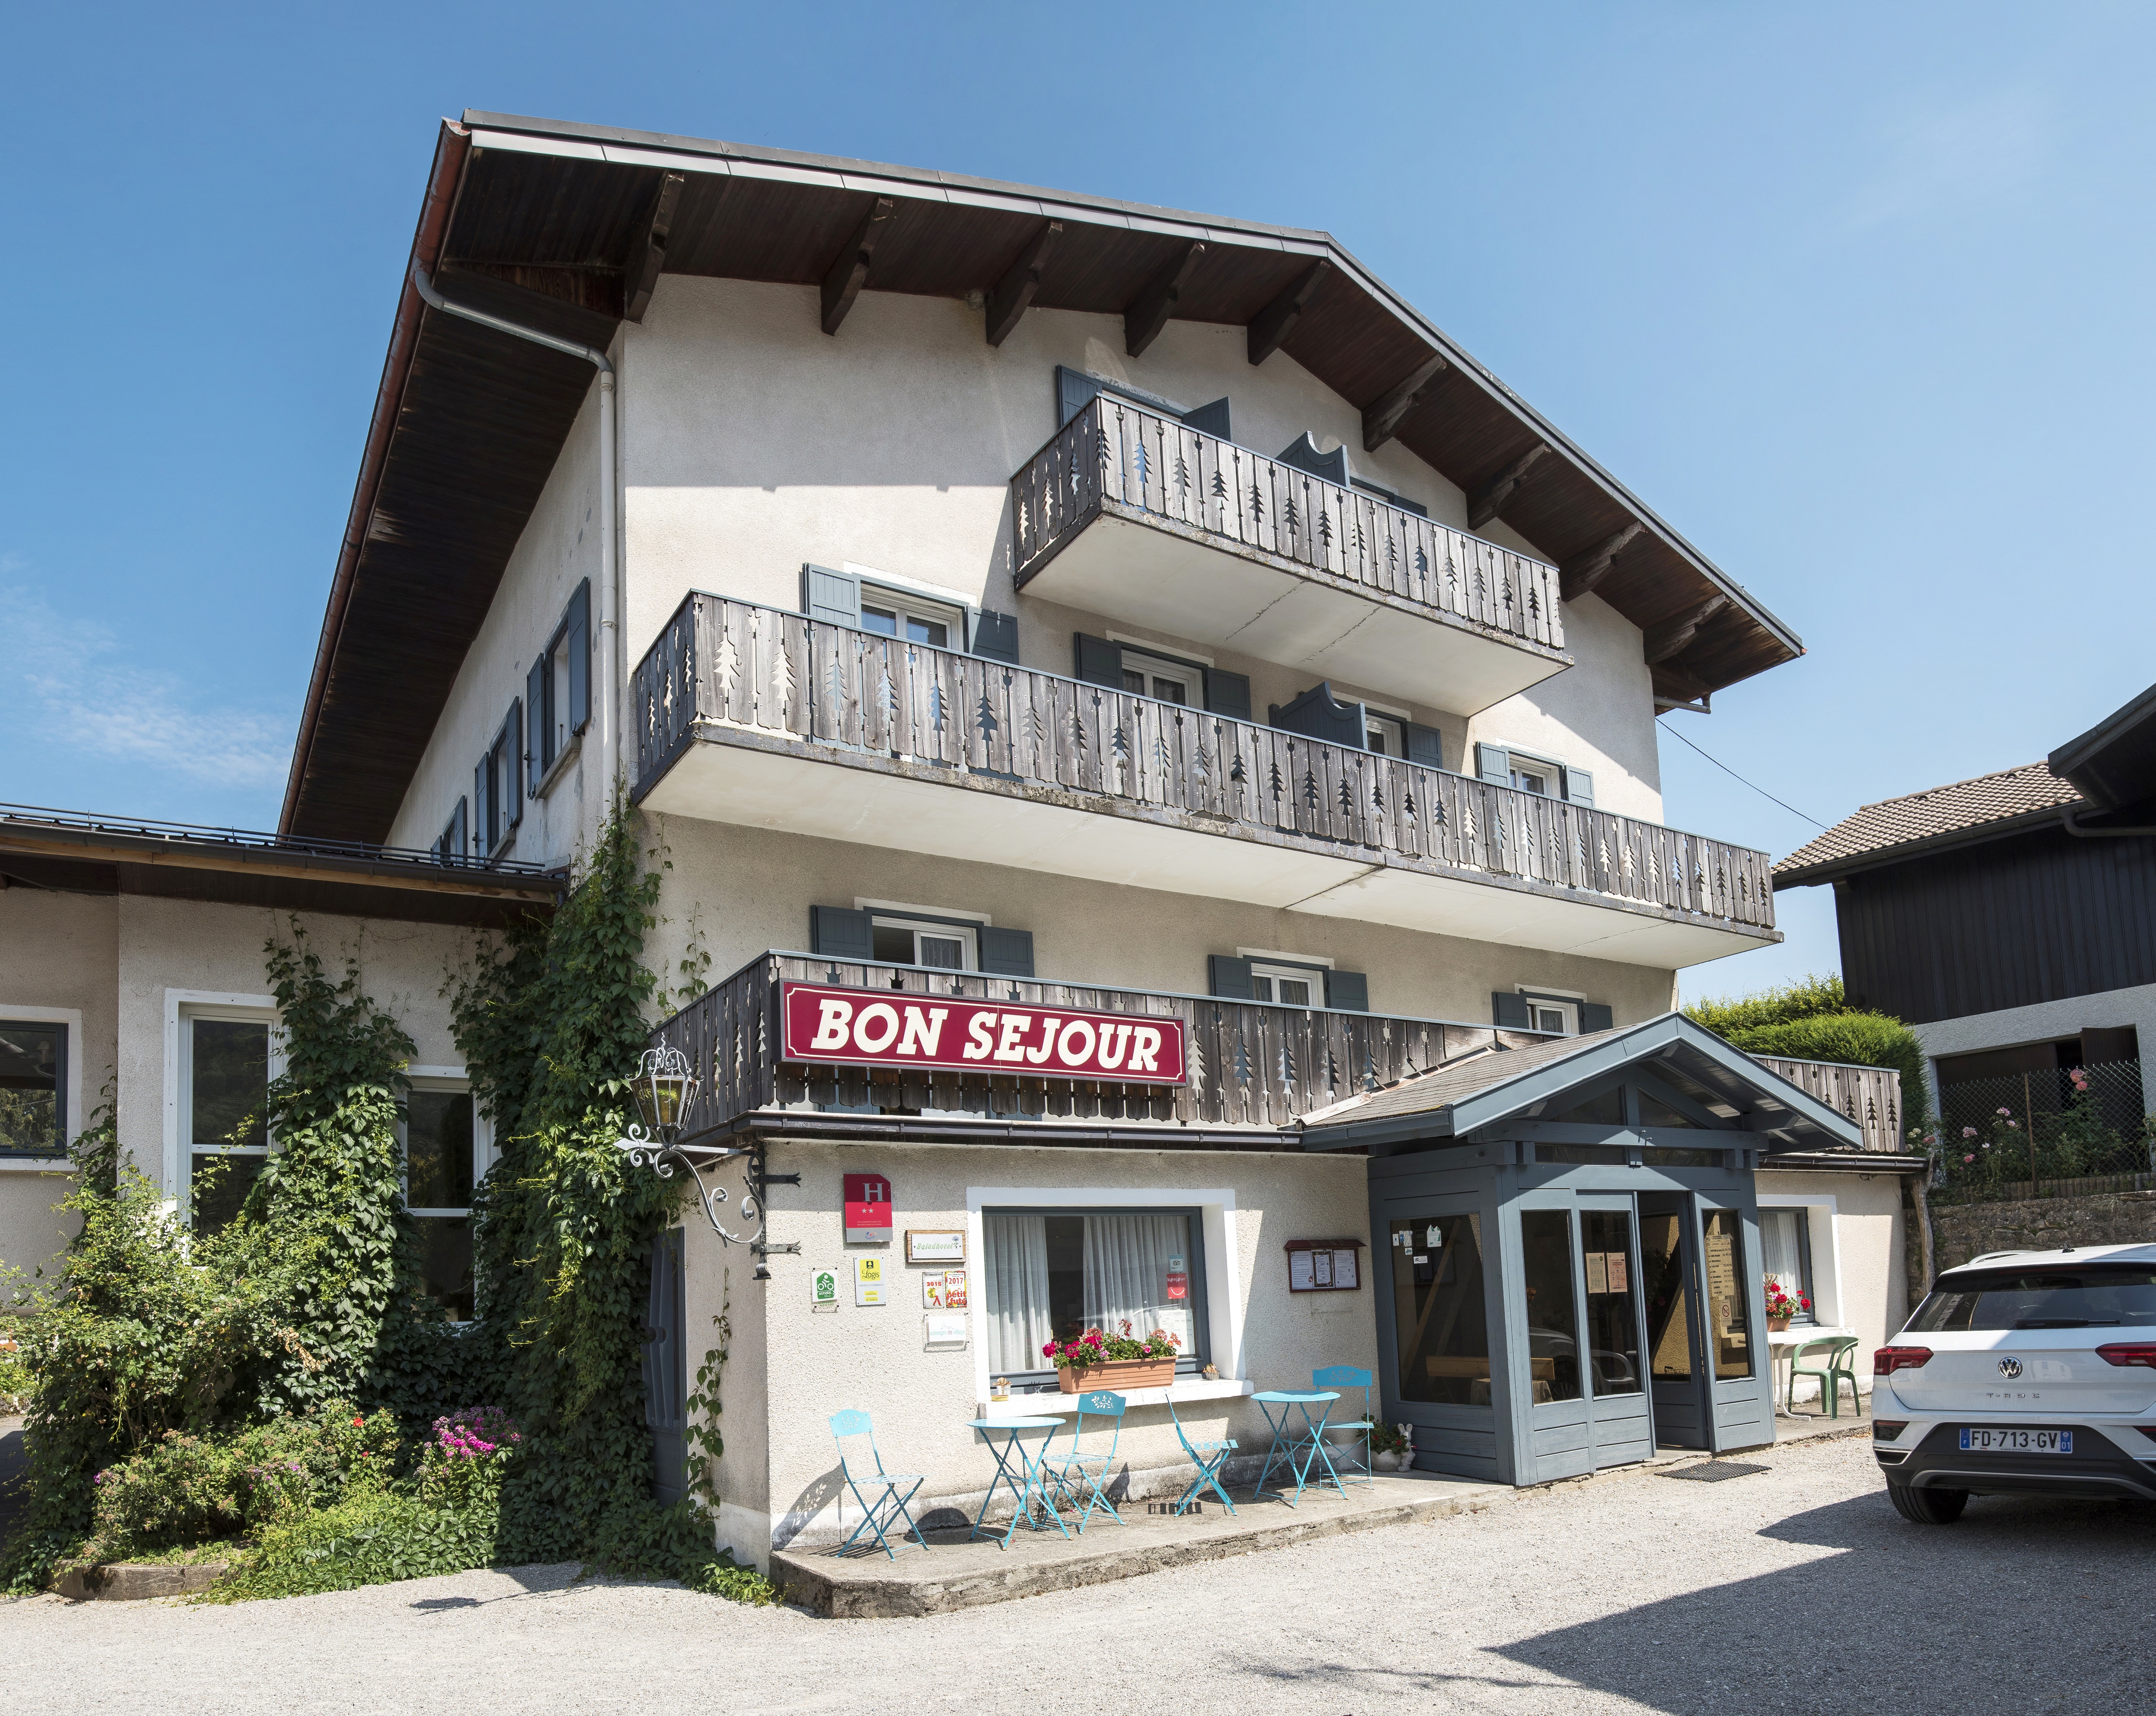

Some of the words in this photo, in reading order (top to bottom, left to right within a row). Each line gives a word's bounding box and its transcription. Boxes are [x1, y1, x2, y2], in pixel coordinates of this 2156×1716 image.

[810, 999, 949, 1056] BON
[962, 1011, 1162, 1072] SEJOUR
[862, 1183, 885, 1202] H
[862, 1269, 879, 1280] Logis
[947, 1291, 967, 1300] petit
[1971, 1430, 2058, 1448] FD-713-GV
